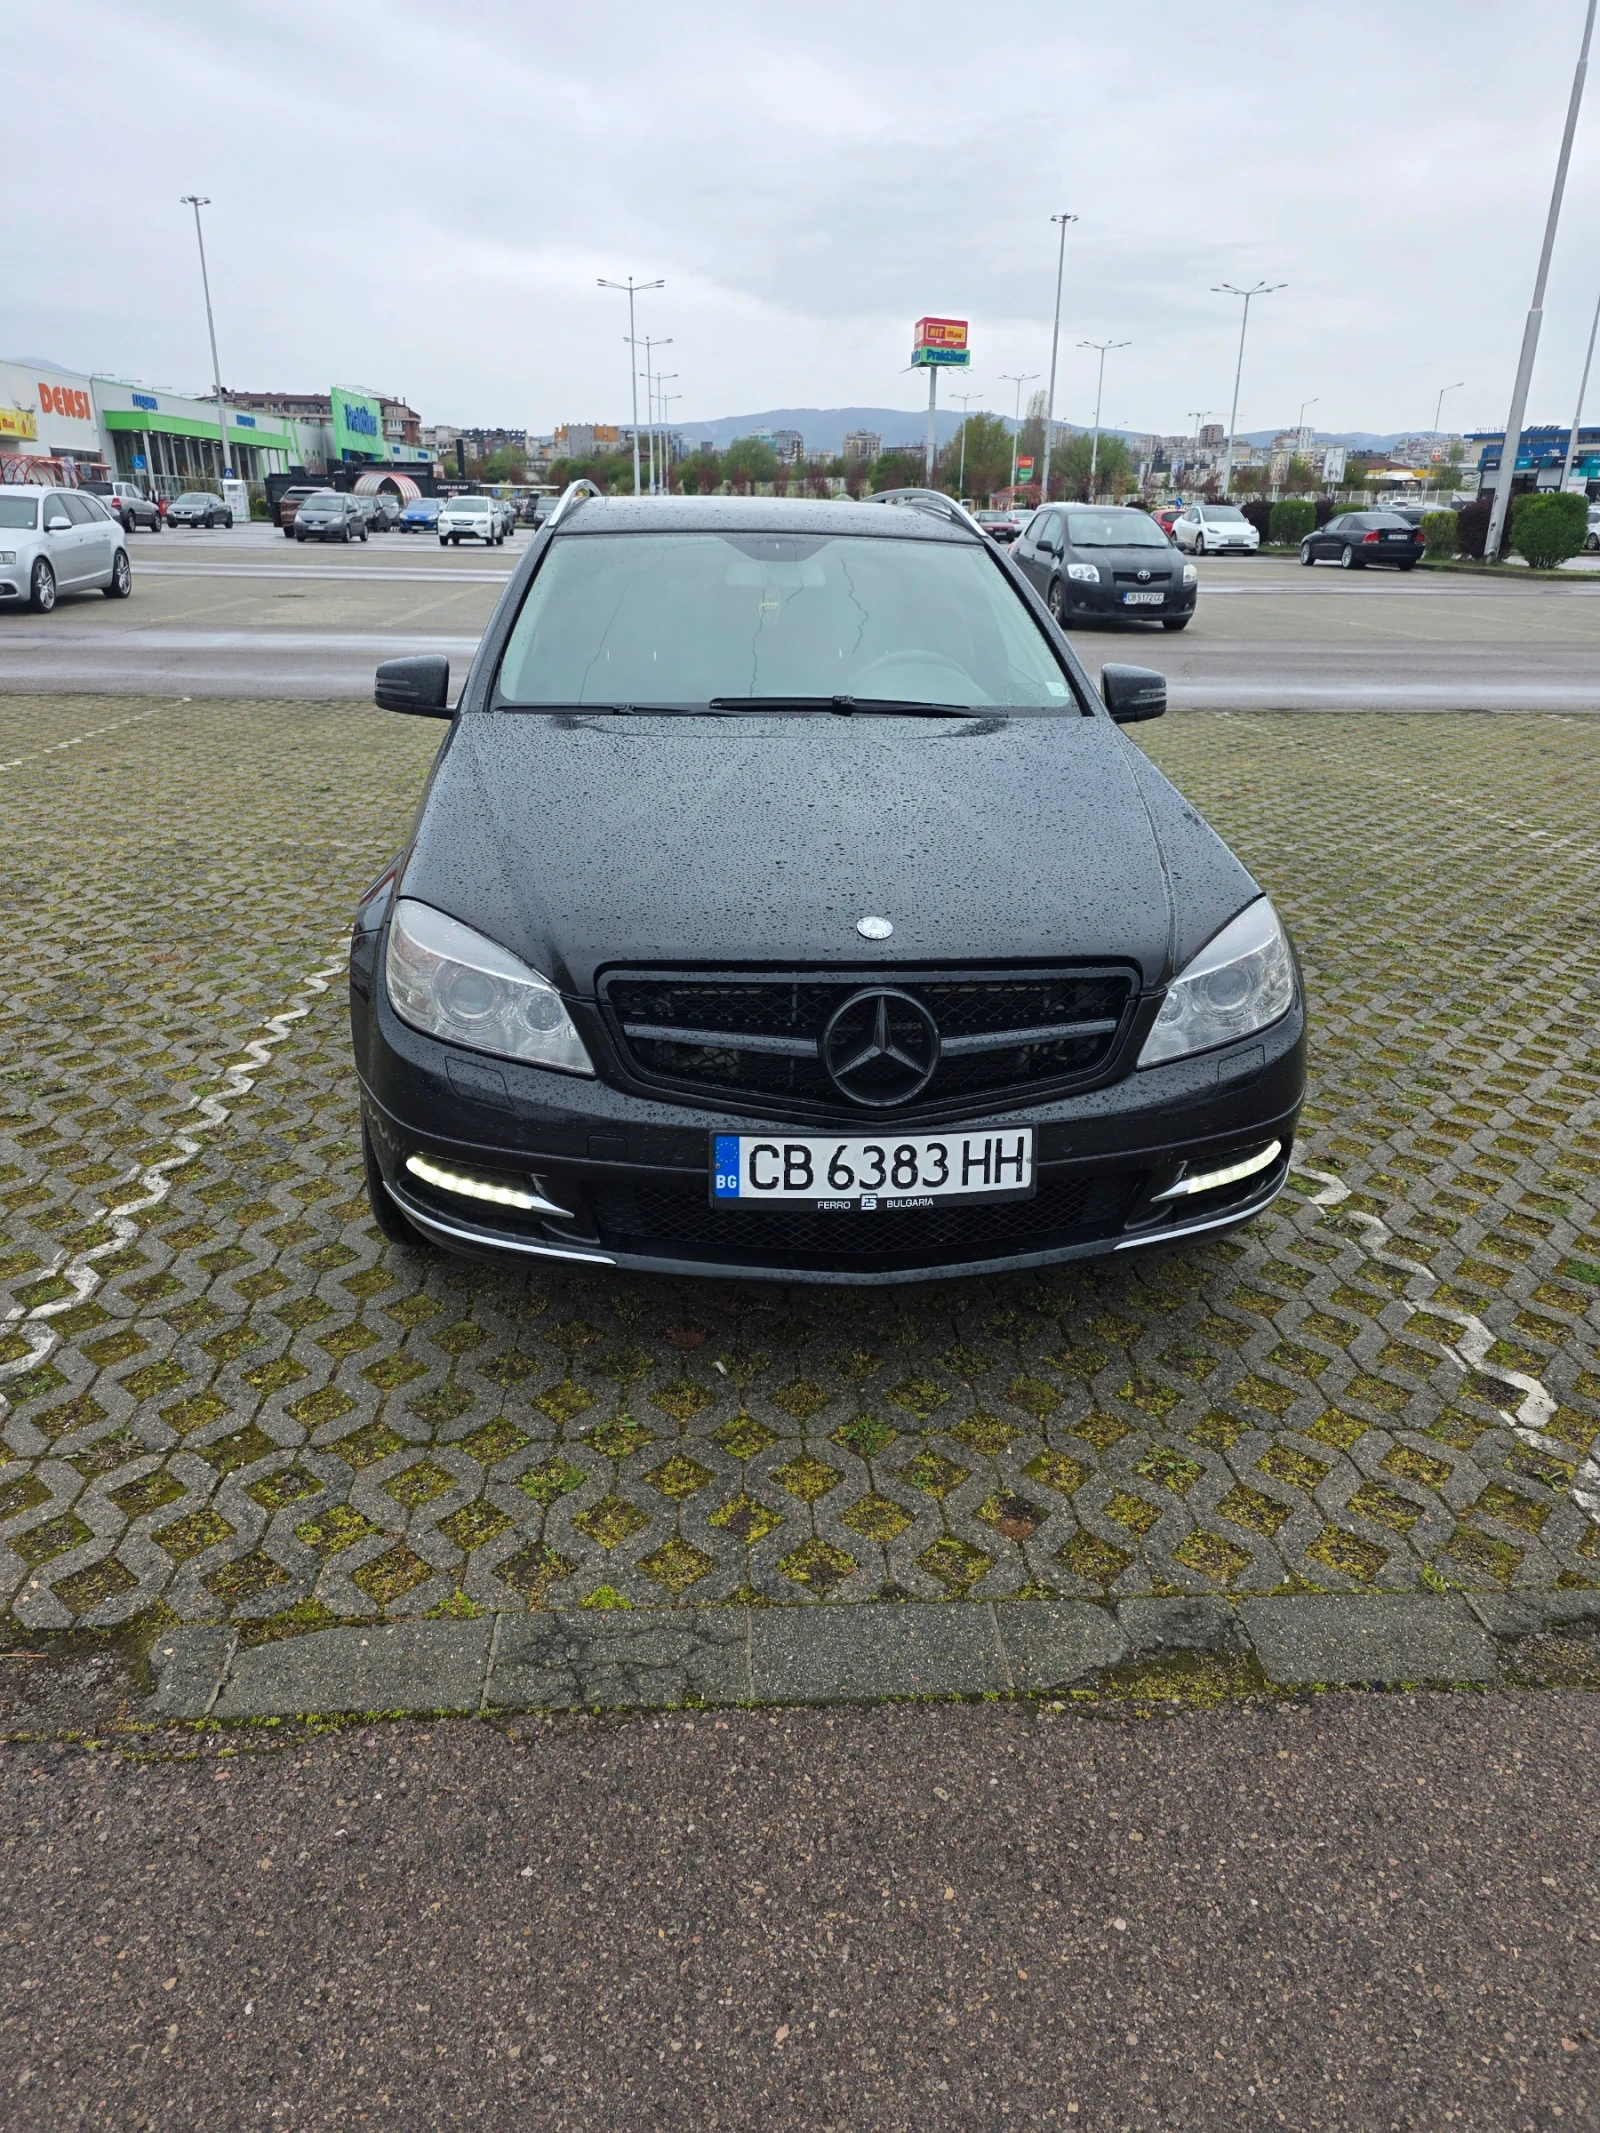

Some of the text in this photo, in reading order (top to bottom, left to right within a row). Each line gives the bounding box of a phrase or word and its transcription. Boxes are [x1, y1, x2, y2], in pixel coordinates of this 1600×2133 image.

[930, 328, 962, 339] HIT Max
[927, 349, 967, 362] Praktiker
[38, 383, 91, 420] DENSI
[344, 403, 377, 437] Praktiker
[749, 1137, 1025, 1191] CB 6383 HH
[716, 1175, 737, 1189] BG
[817, 1201, 851, 1210] FERRO
[886, 1197, 934, 1209] BULGARIA
